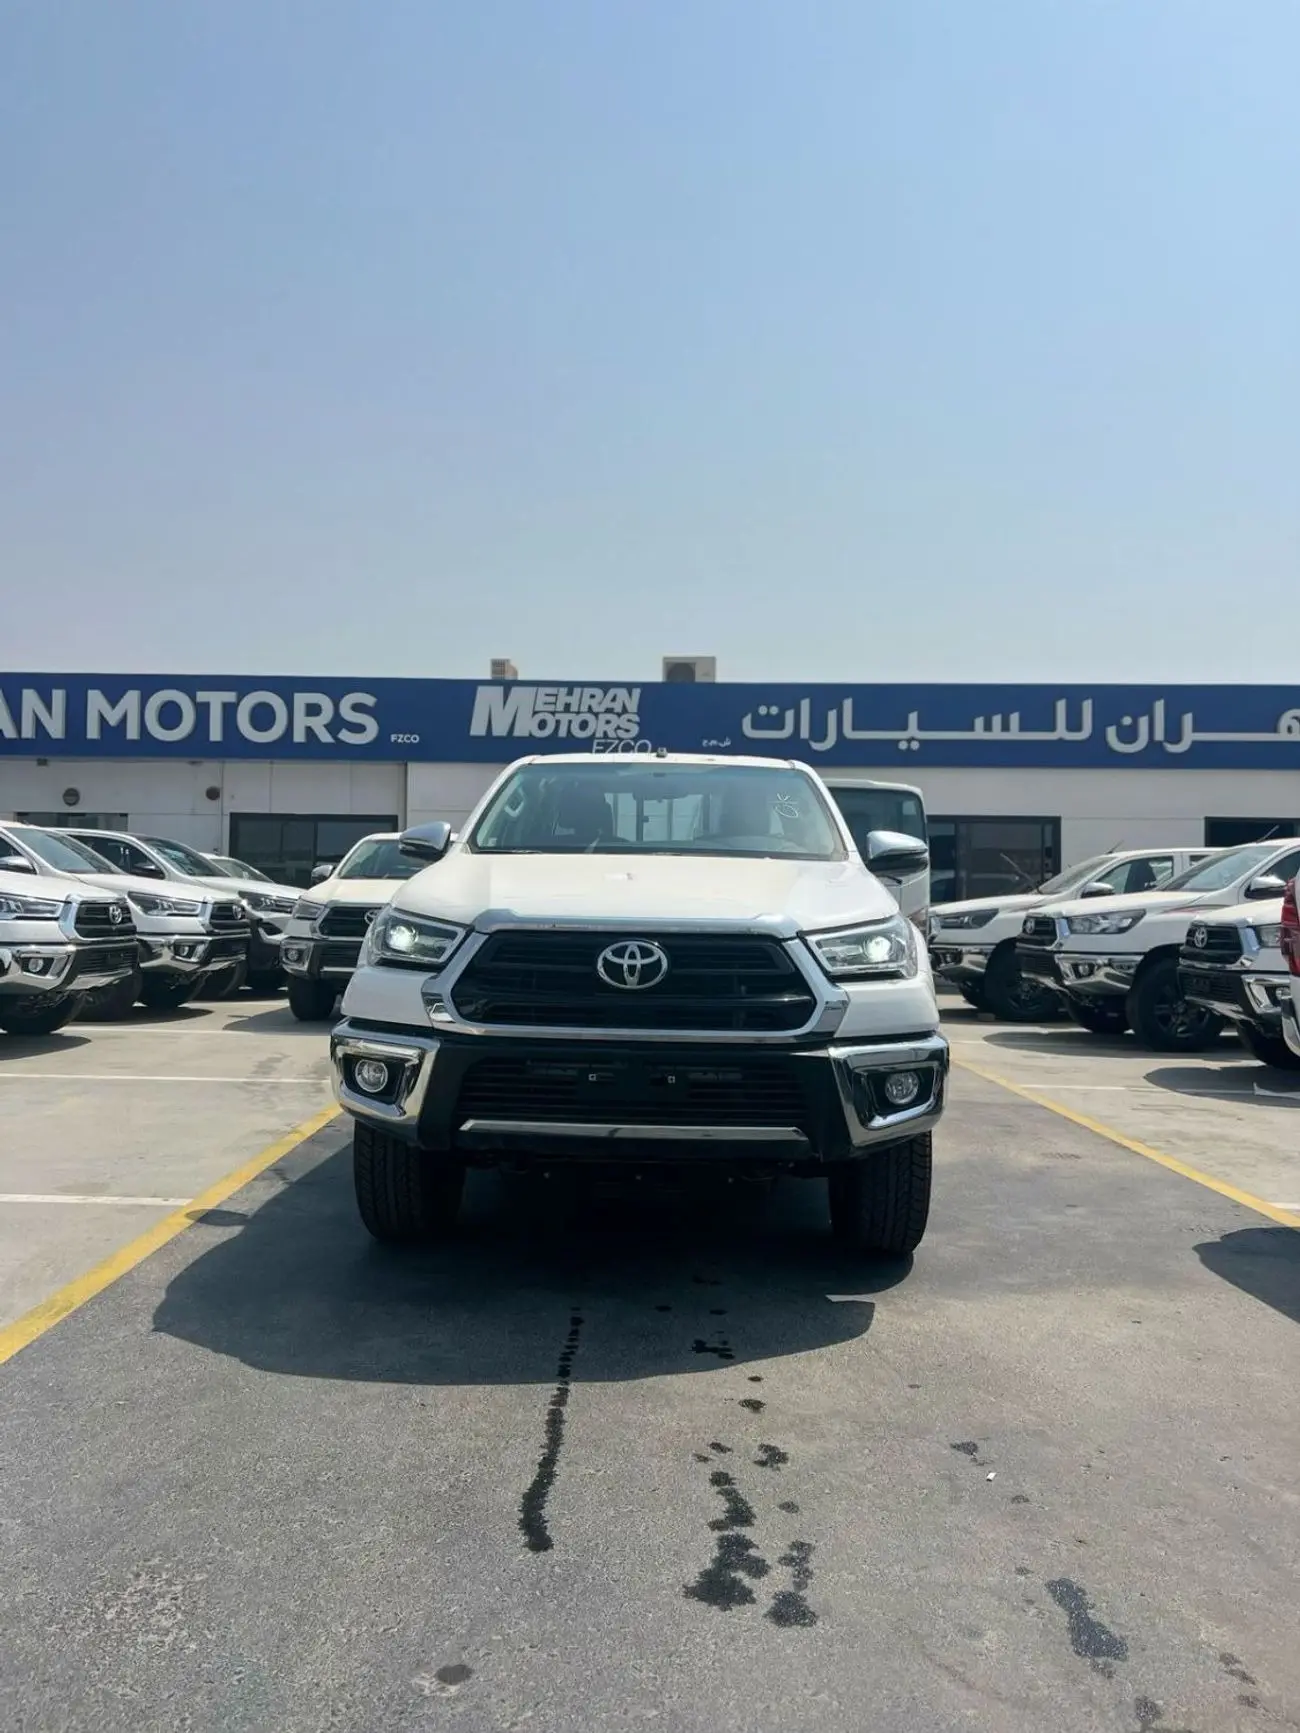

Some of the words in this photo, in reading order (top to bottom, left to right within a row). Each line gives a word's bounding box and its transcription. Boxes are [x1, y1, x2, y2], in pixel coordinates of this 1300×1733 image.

[86, 689, 379, 745] MOTORS
[390, 734, 420, 743] FZCO
[742, 698, 1092, 751] للسيارات
[592, 739, 652, 753] FZCO
